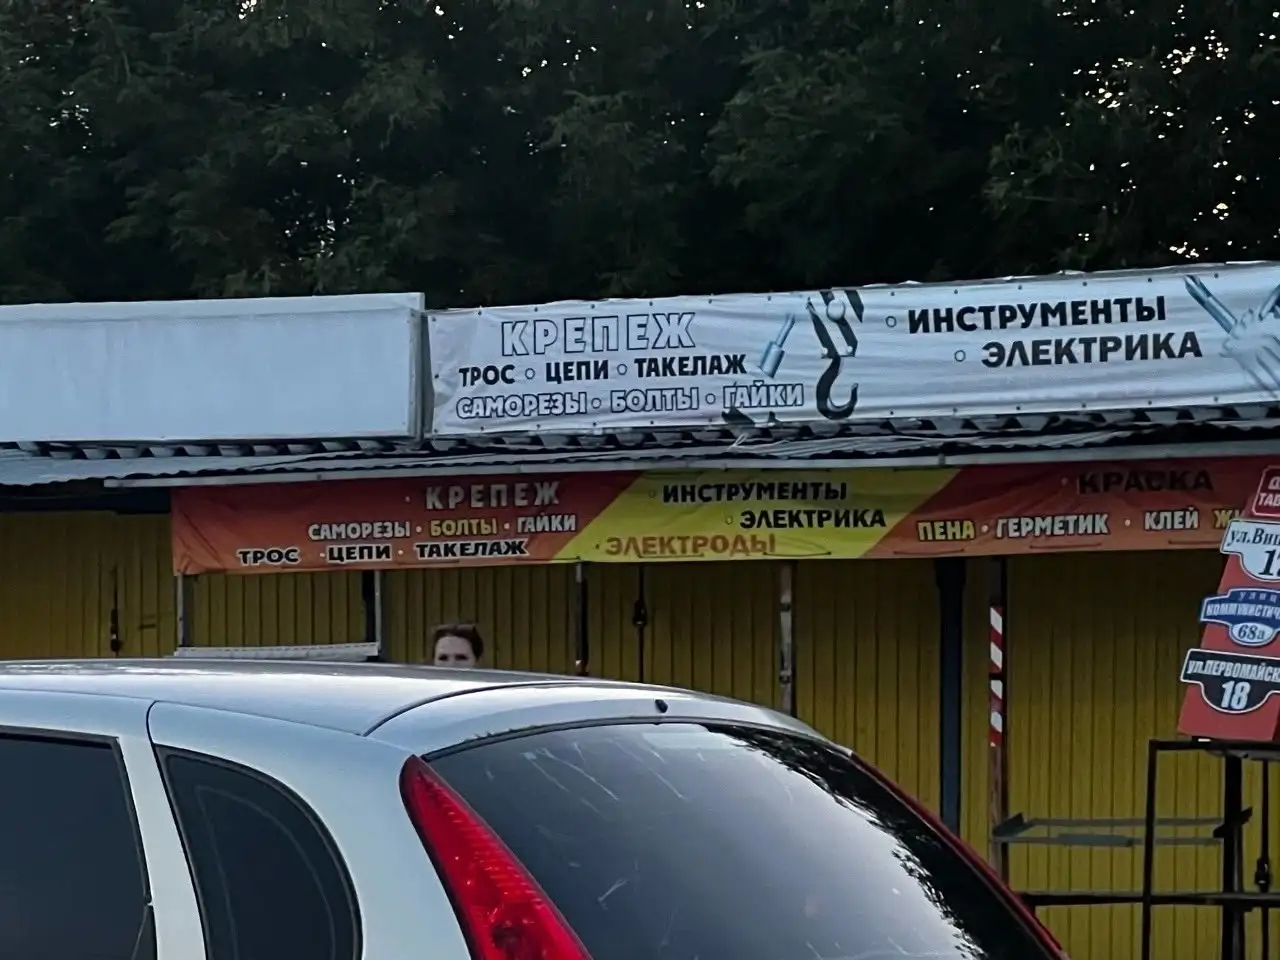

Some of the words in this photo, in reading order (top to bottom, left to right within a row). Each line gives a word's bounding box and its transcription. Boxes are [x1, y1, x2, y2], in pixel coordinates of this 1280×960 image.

[908, 296, 1167, 333] ИНСТРУМЕНТЫ
[501, 312, 697, 357] КРЕПЕЖ
[981, 331, 1203, 367] ЭЛЕКТРИКА
[458, 363, 515, 387] ТРОС
[545, 359, 609, 384] ЦЕПИ
[633, 354, 748, 379] ТАКЕЛАЖ
[456, 391, 586, 419] САМОРЕЗЫ
[610, 387, 699, 413] БОЛТЫ
[723, 381, 805, 409] ГАЙКИ
[425, 480, 561, 510] КРЕПЕЖ
[662, 481, 848, 503] ИНСТРУМЕНТЫ
[1077, 469, 1214, 494] КРАСКА
[308, 521, 410, 541] САМОРЕЗЫ
[429, 517, 498, 538] БОЛТЫ
[517, 513, 577, 534] ГАЙКИ
[739, 509, 886, 529] ЭЛЕКТРИКА
[917, 519, 976, 541] ПЕНА
[995, 513, 1109, 539] ГЕРМЕТИК
[1144, 506, 1200, 531] КЛЕЙ
[1213, 509, 1241, 529] Ж
[238, 548, 300, 565] ТРОС
[327, 544, 393, 562] ЦЕПИ
[414, 539, 530, 560] ТАКЕЛАЖ
[604, 534, 777, 557] ЭЛЕКТРОДЫ
[1259, 550, 1280, 576] 1
[1221, 680, 1251, 709] 18
